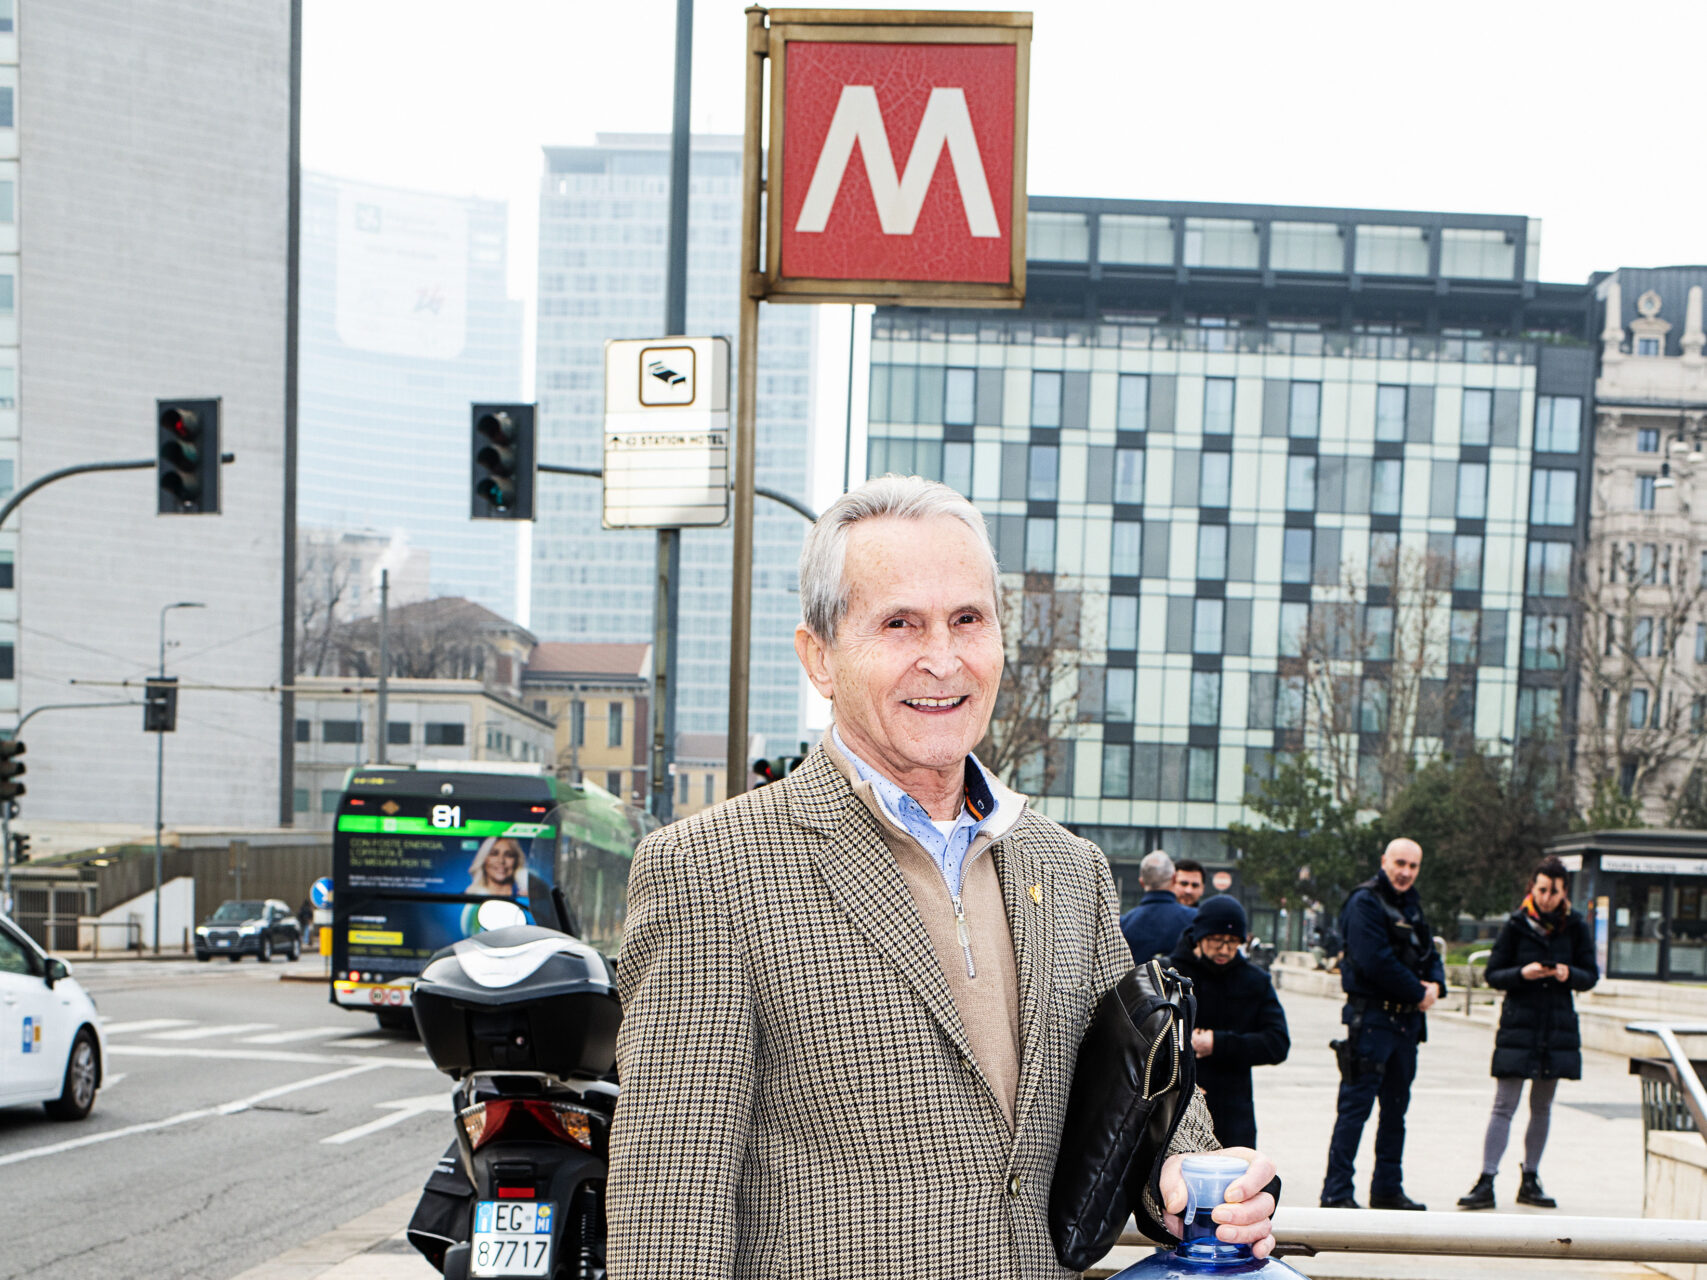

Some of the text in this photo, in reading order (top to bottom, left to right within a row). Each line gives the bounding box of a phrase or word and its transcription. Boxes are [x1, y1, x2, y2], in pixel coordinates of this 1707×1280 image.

[795, 85, 1000, 237] M
[690, 434, 724, 445] HOTEL
[432, 804, 461, 829] 81
[496, 1205, 523, 1231] EG
[536, 1218, 550, 1232] MI
[477, 1241, 548, 1269] 87717
